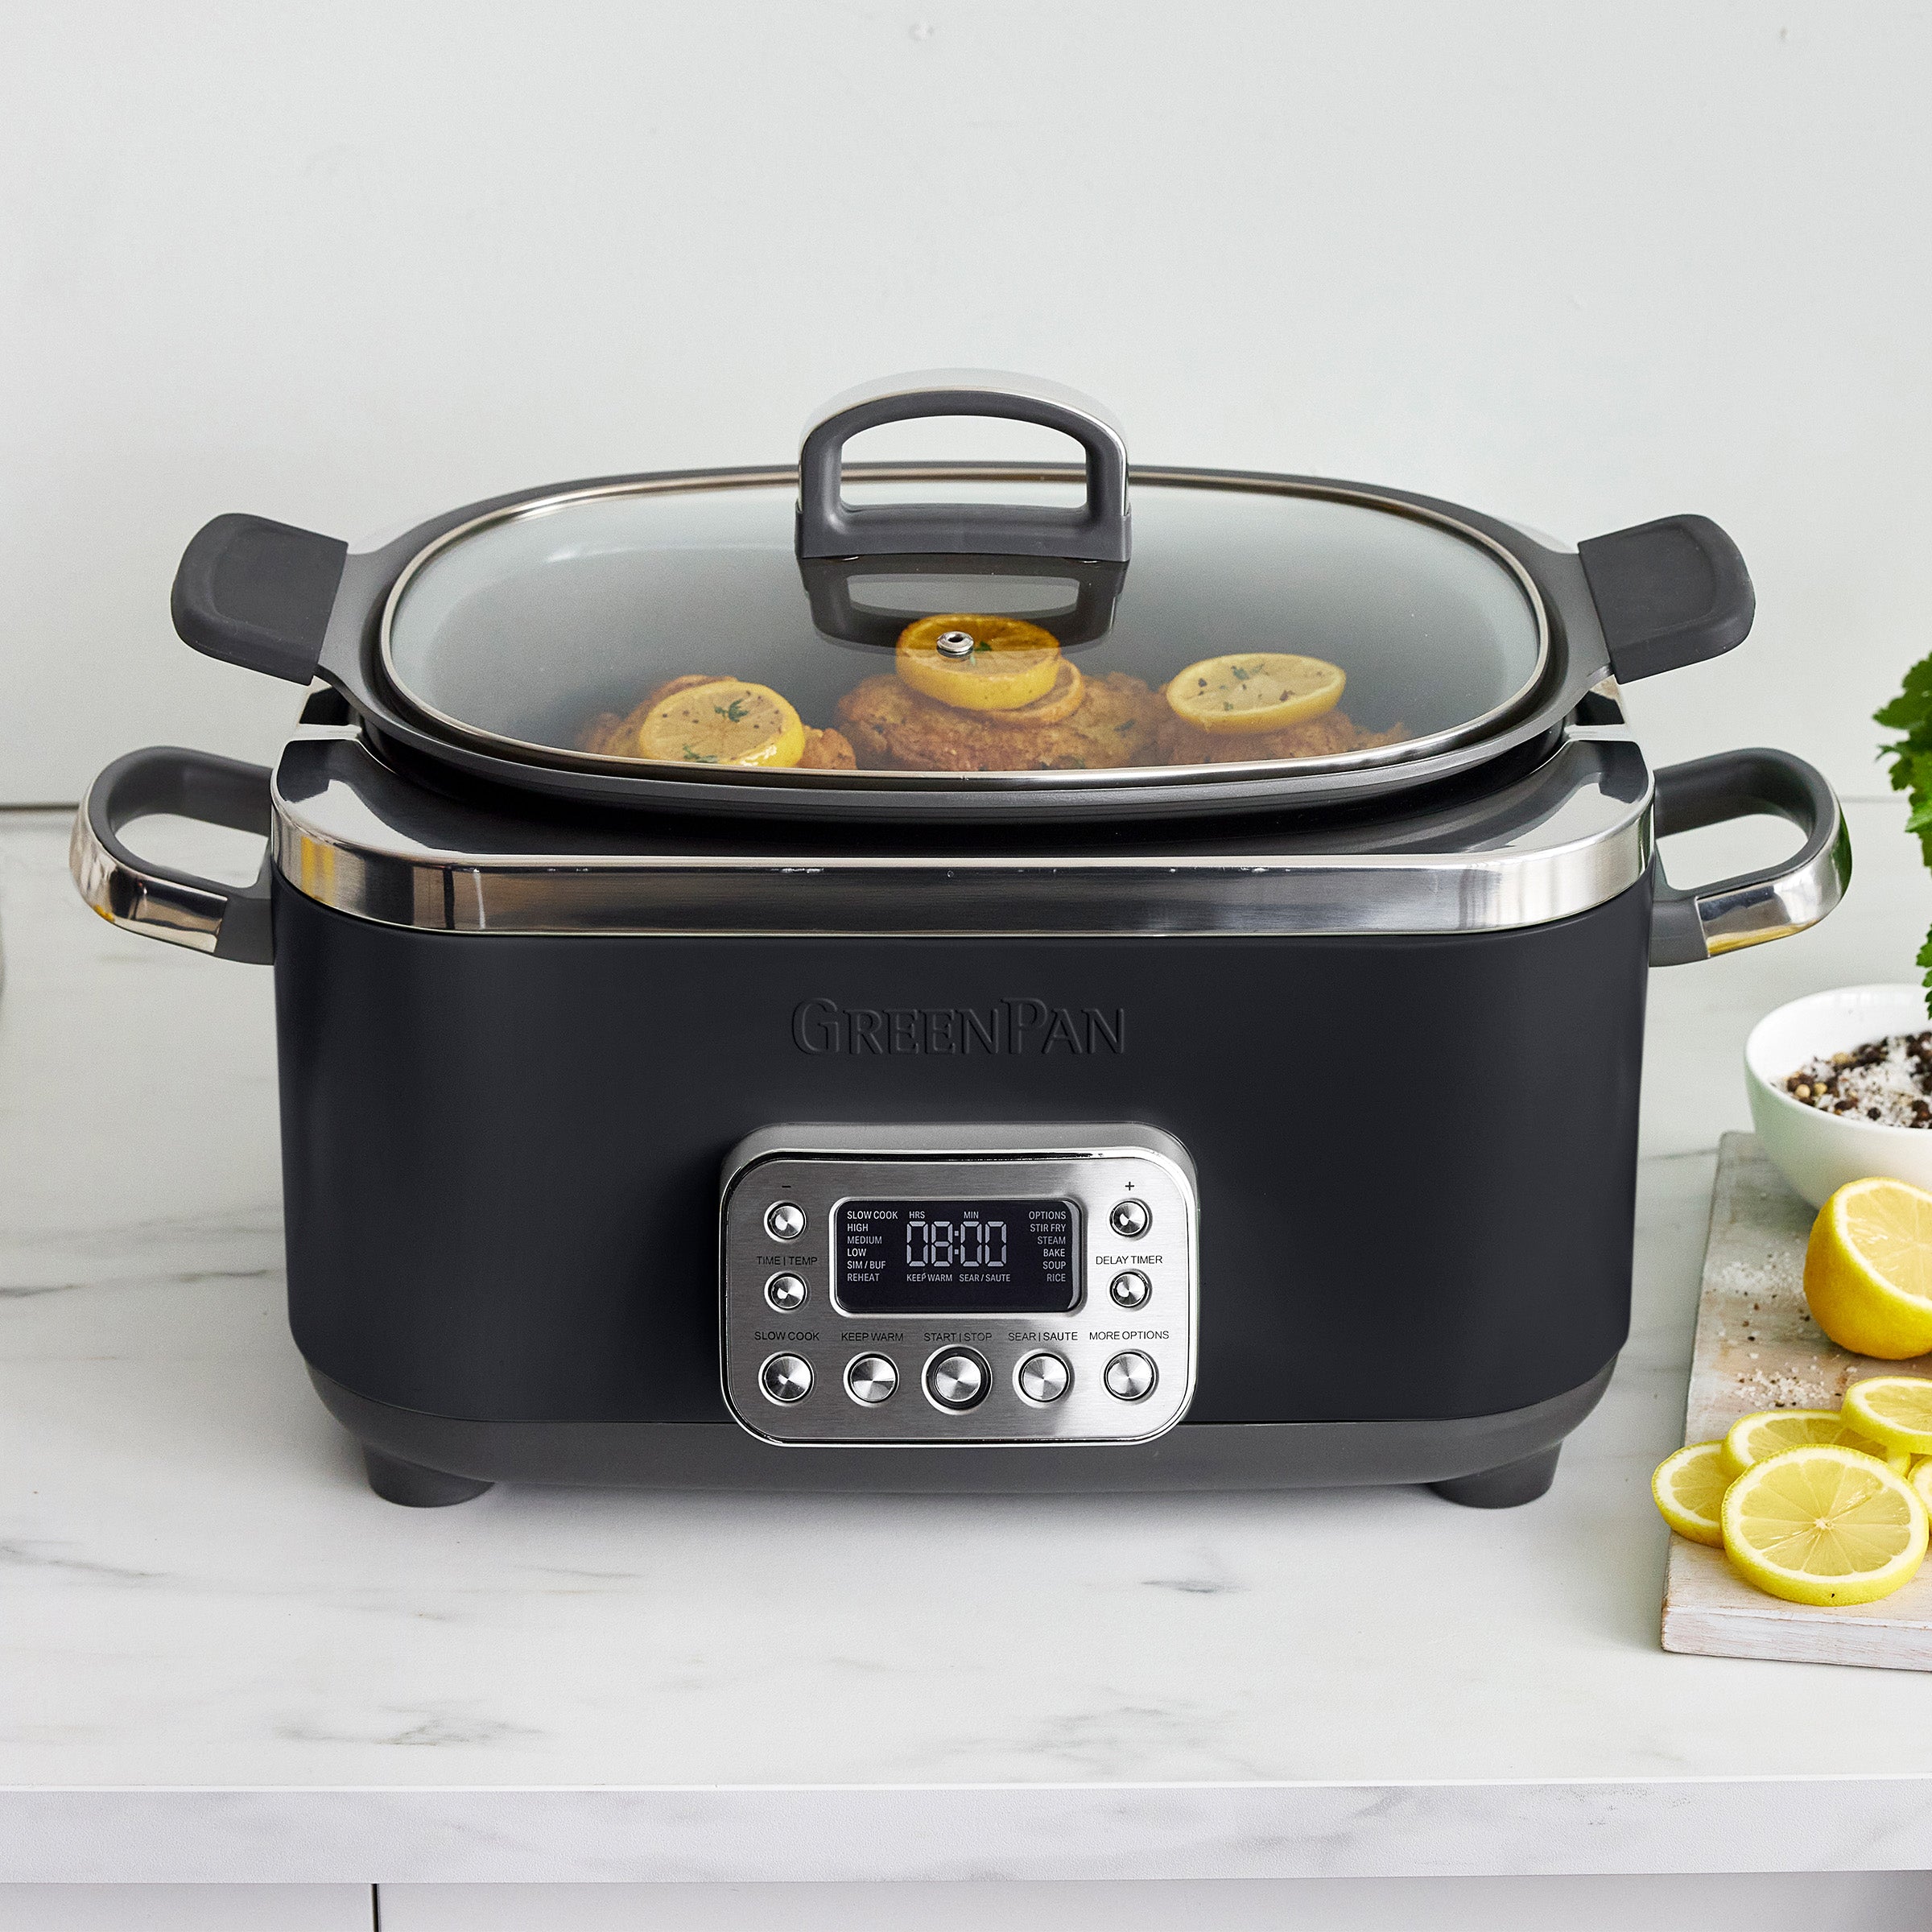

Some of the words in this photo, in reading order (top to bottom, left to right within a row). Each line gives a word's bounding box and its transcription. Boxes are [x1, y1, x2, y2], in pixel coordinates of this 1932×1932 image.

[847, 1211, 872, 1220] SLOW
[873, 1211, 898, 1220] COOK
[909, 1211, 925, 1219] HRS
[964, 1211, 979, 1219] MIN
[1028, 1211, 1067, 1220] OPTIONS
[847, 1223, 869, 1232] HIGH
[1030, 1224, 1048, 1232] STIR
[1051, 1224, 1067, 1232] FRY
[847, 1236, 882, 1245] MEDIUM
[906, 1221, 1007, 1267] 08:00
[1037, 1236, 1066, 1245] STEAM
[847, 1248, 867, 1257] LOW
[1043, 1249, 1066, 1257] BAKE
[757, 1256, 781, 1265] TIME
[789, 1256, 818, 1265] TEMP
[1096, 1255, 1129, 1265] DELAY
[1131, 1255, 1163, 1265] TIMER
[847, 1261, 863, 1269] SIM
[869, 1261, 886, 1269] BUF
[1042, 1261, 1067, 1269] SOUP
[847, 1273, 880, 1282] REHEAT
[906, 1274, 927, 1282] KEEP
[927, 1274, 953, 1282] WARM
[959, 1274, 980, 1282] SEAR
[985, 1274, 1010, 1282] SAUTE
[1046, 1273, 1067, 1282] RICE
[753, 1331, 786, 1340] SLOW
[787, 1331, 820, 1341] COOK
[841, 1332, 869, 1341] KEEP
[870, 1332, 904, 1341] WARM
[923, 1332, 957, 1342] START
[964, 1332, 993, 1342] STOP
[1008, 1332, 1036, 1341] SEAR
[1043, 1331, 1078, 1341] SAUTE
[1089, 1331, 1120, 1340] MORE
[1121, 1331, 1169, 1340] OPTIONS
